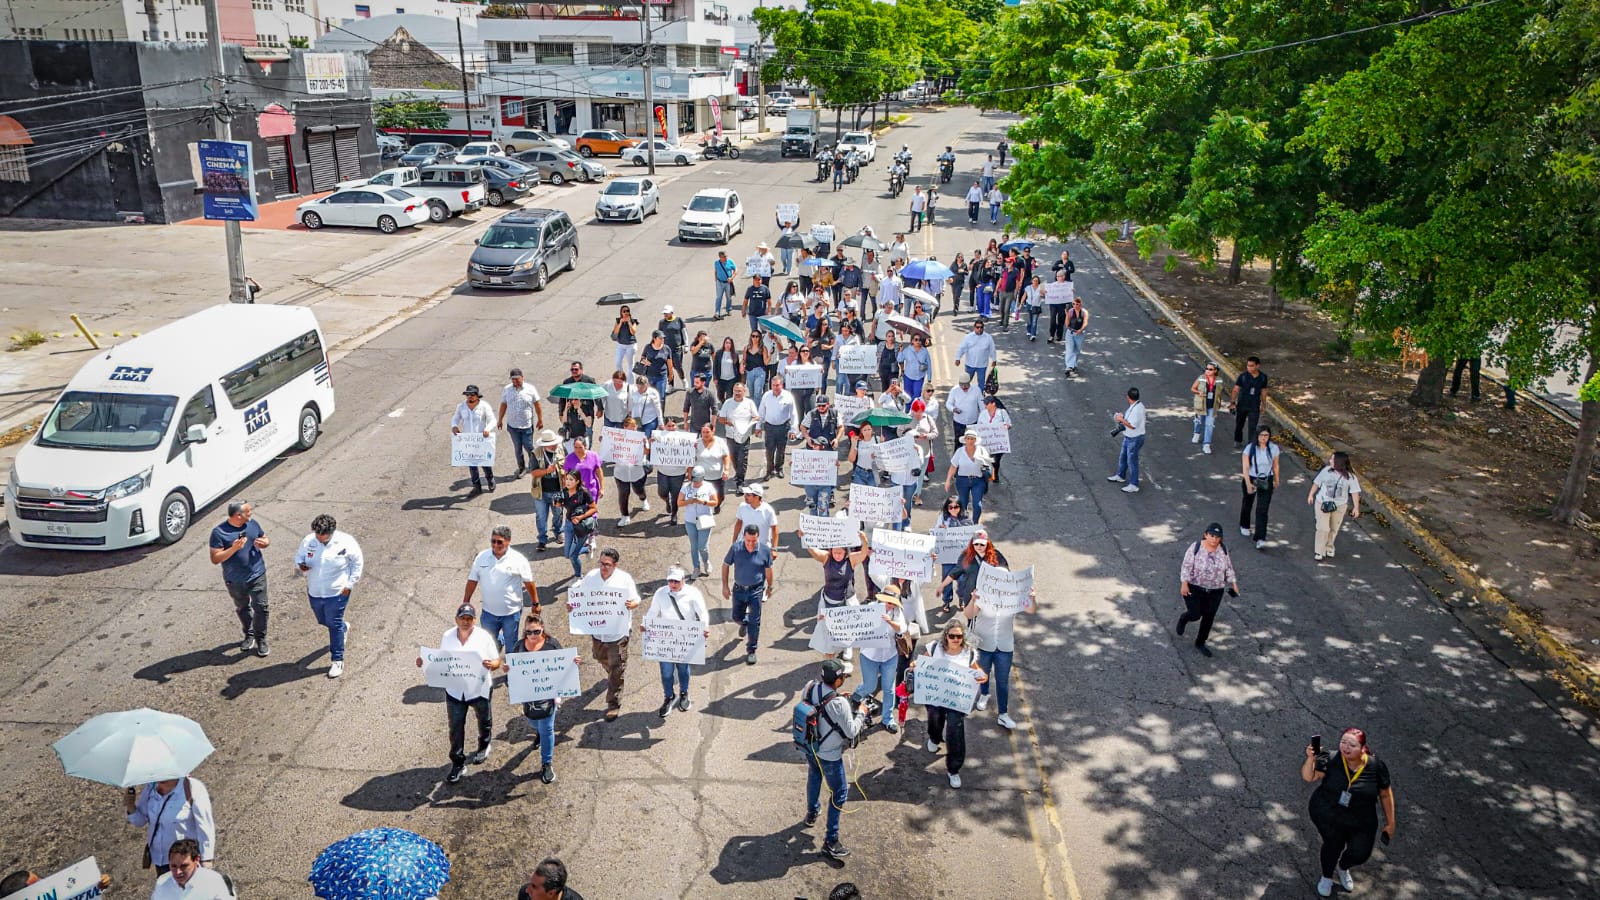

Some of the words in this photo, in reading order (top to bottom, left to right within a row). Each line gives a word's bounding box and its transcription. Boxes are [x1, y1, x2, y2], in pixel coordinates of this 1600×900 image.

[206, 161, 236, 169] CINEMA
[877, 531, 926, 546] Justicia
[874, 547, 894, 558] para
[903, 548, 914, 560] la
[590, 590, 623, 598] DOCENTE
[588, 619, 607, 627] VIDA
